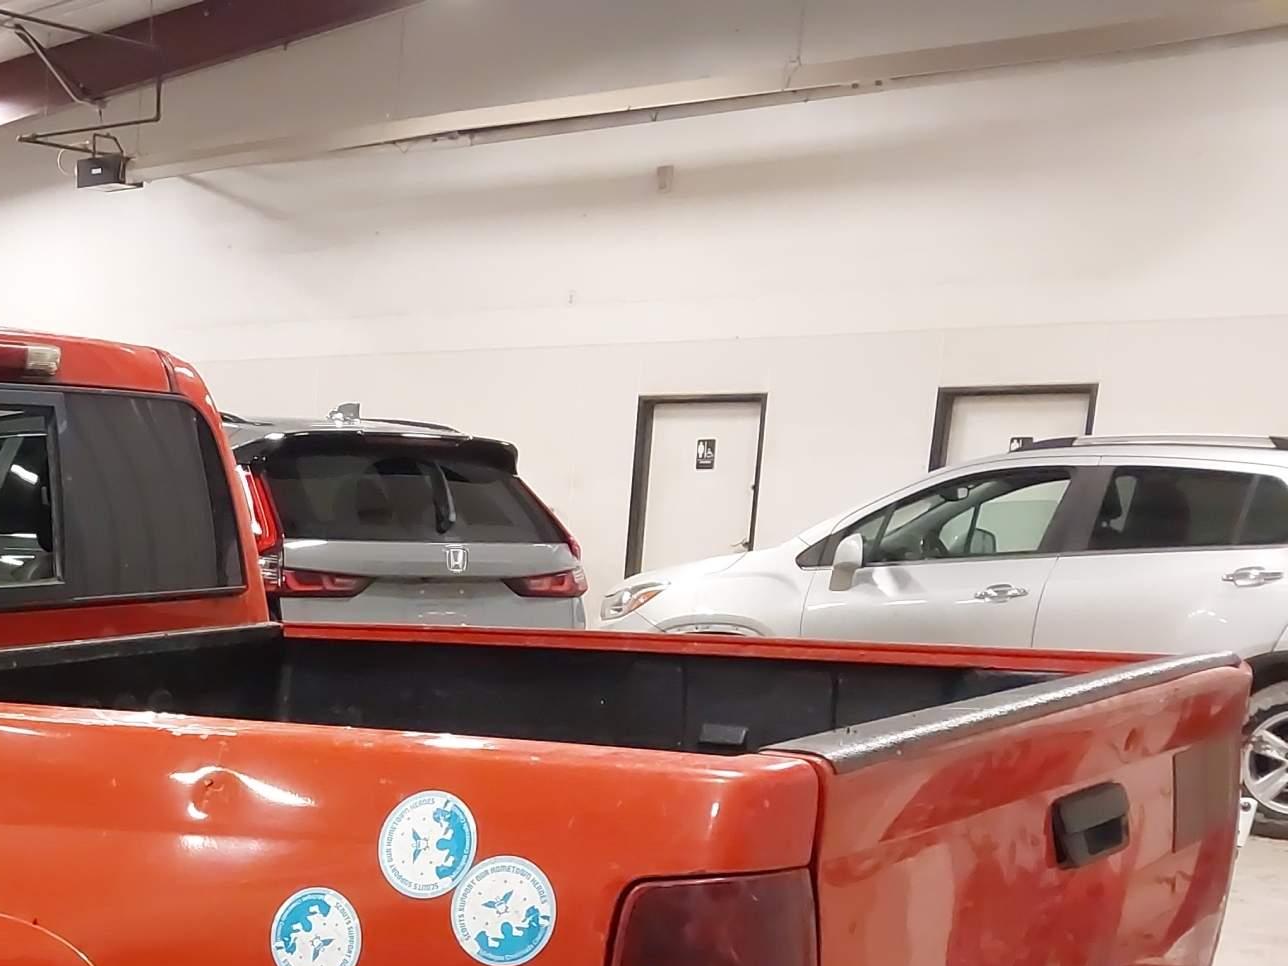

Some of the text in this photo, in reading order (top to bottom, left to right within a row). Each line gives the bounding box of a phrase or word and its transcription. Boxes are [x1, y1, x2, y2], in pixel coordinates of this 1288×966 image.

[389, 863, 412, 888] SUPPORT
[490, 865, 532, 880] HOMETOWN
[413, 882, 439, 891] SCOUTS
[459, 880, 476, 912] SUPPORT
[530, 877, 548, 904] HEROES
[458, 913, 471, 941] SCOUTS
